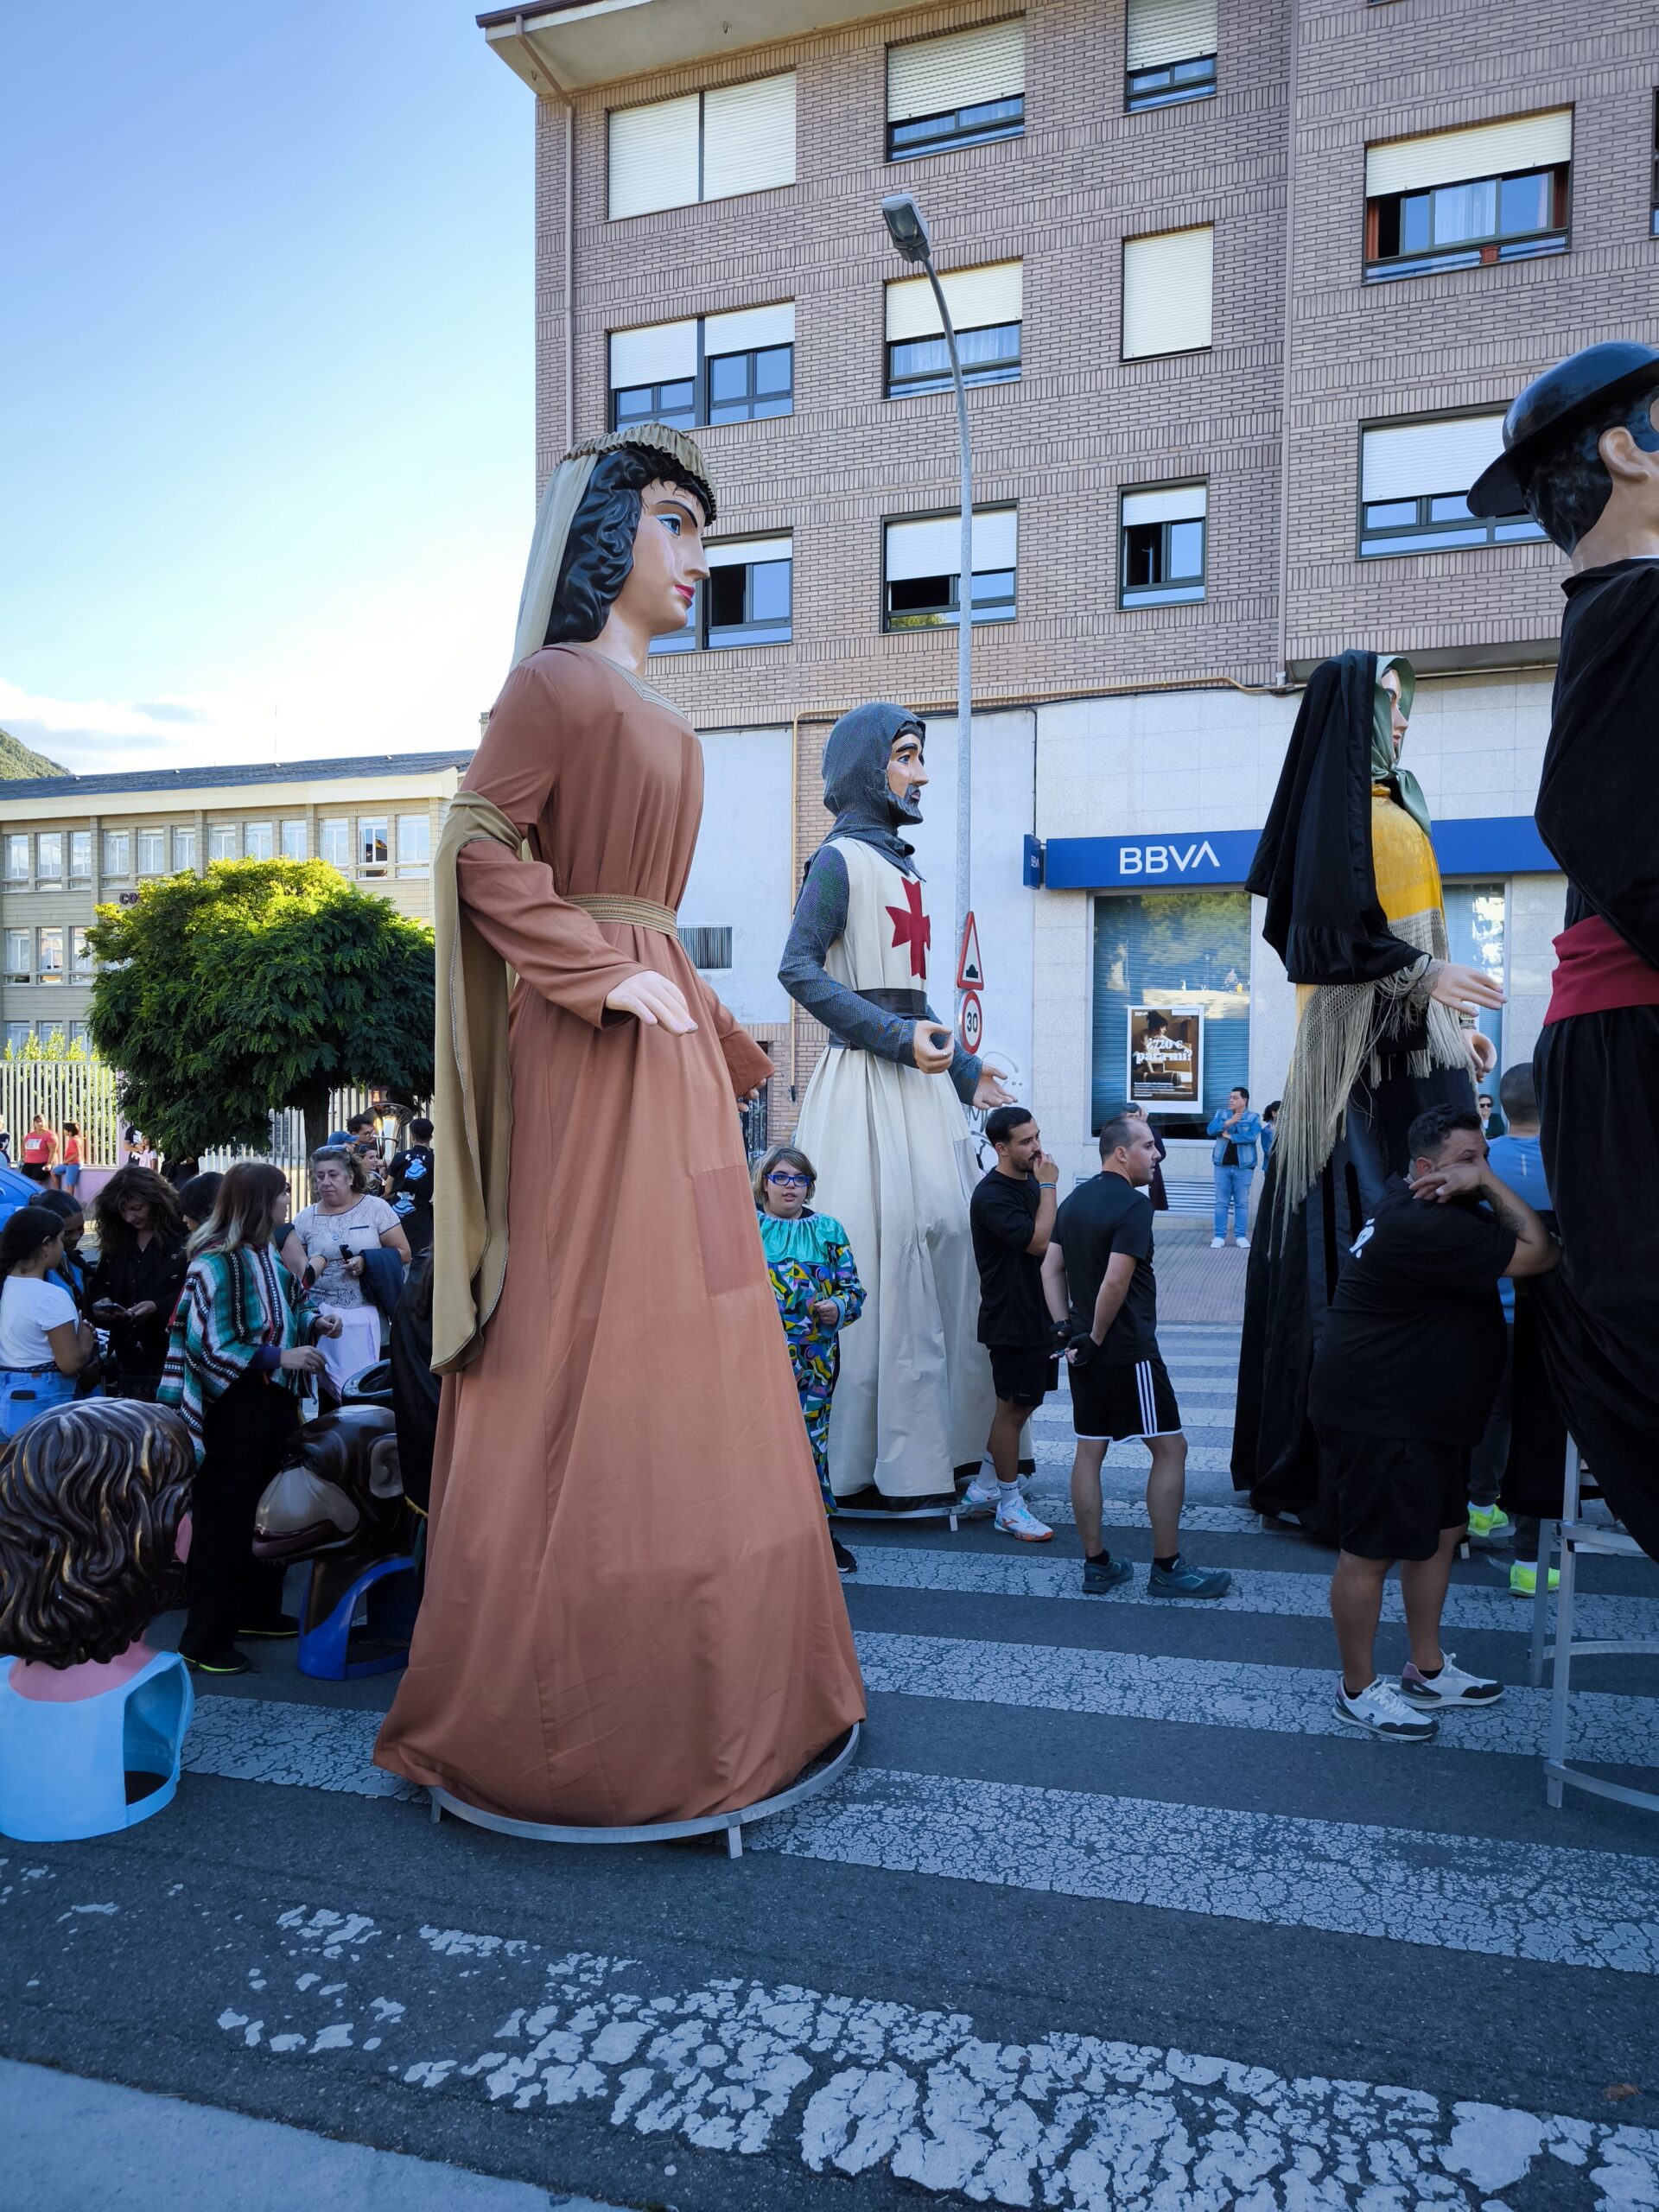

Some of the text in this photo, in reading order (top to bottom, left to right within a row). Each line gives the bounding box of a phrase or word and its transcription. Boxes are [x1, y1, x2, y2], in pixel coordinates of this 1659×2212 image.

[1120, 840, 1221, 874] BBVA
[967, 1011, 978, 1033] 30
[1135, 1052, 1166, 1064] para
